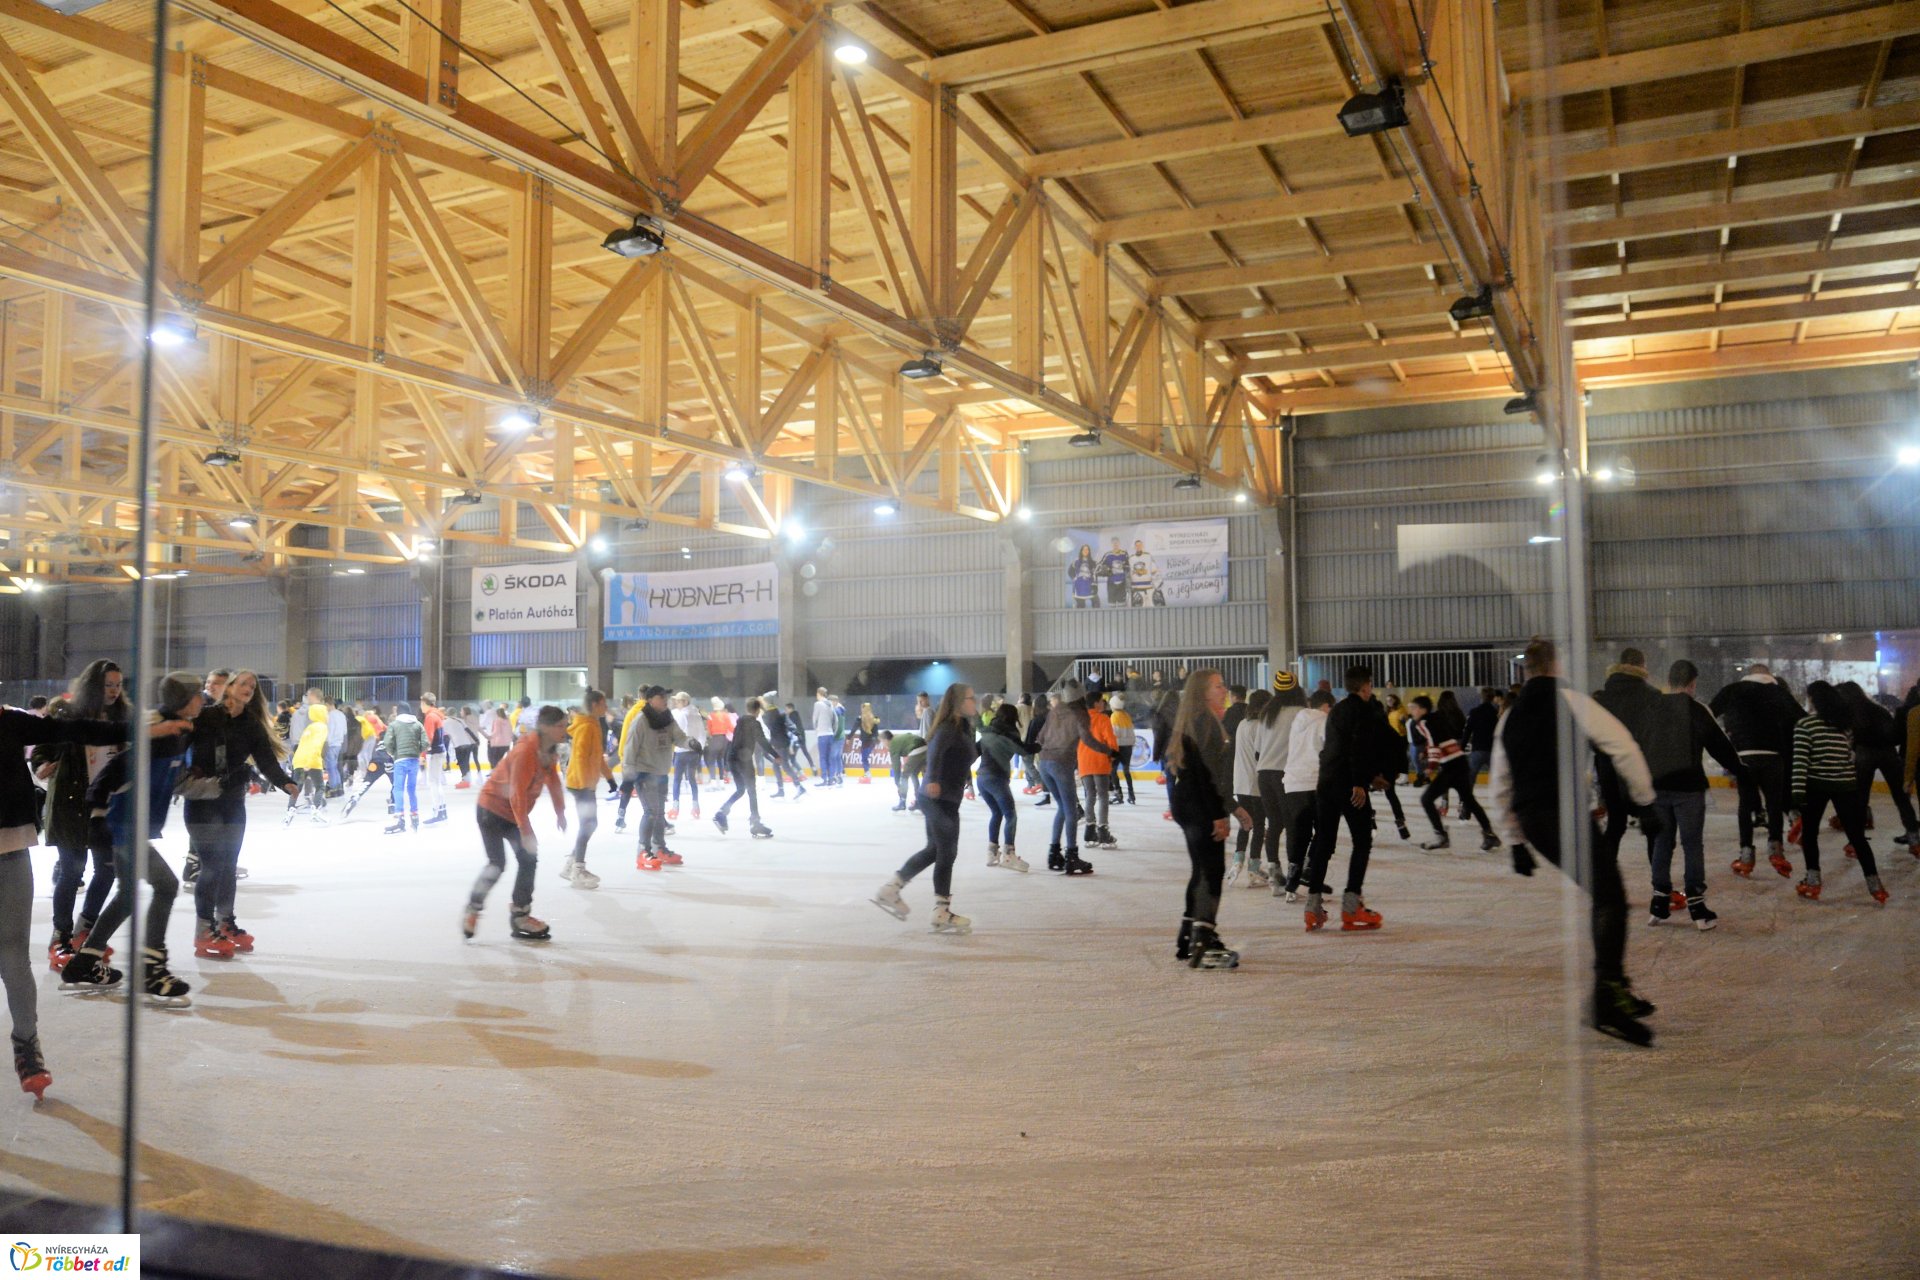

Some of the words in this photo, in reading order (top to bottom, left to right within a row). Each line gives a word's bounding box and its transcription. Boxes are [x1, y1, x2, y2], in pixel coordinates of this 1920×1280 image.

[504, 574, 567, 590] ŠKODA
[649, 579, 773, 609] HÜBNER-H
[488, 608, 523, 621] Platán
[526, 604, 575, 619] Autóház
